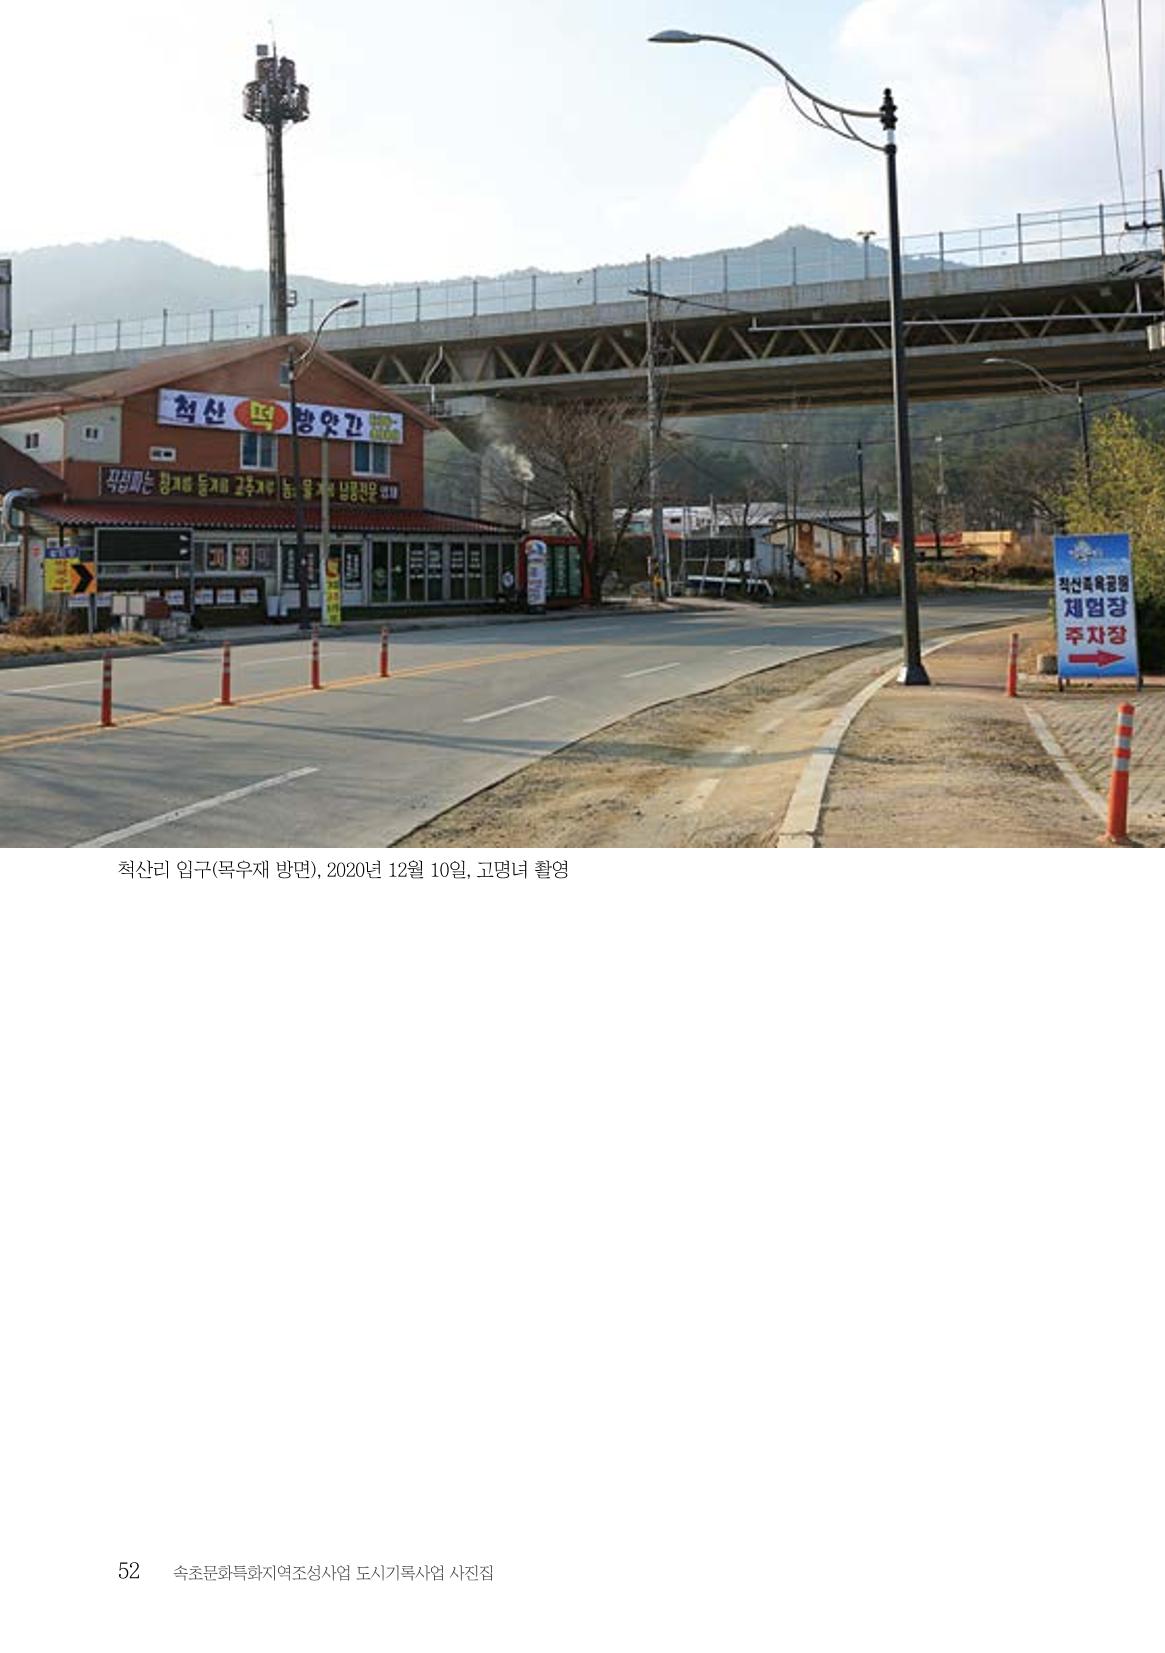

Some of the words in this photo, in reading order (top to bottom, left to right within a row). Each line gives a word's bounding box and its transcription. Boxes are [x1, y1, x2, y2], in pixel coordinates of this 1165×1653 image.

[173, 394, 226, 424] 척산
[249, 400, 275, 431] 떡
[294, 406, 364, 438] 방앗간
[1058, 574, 1130, 594] 척산족욕공원
[1064, 596, 1129, 618] 체험장
[1065, 624, 1127, 646] 주차장
